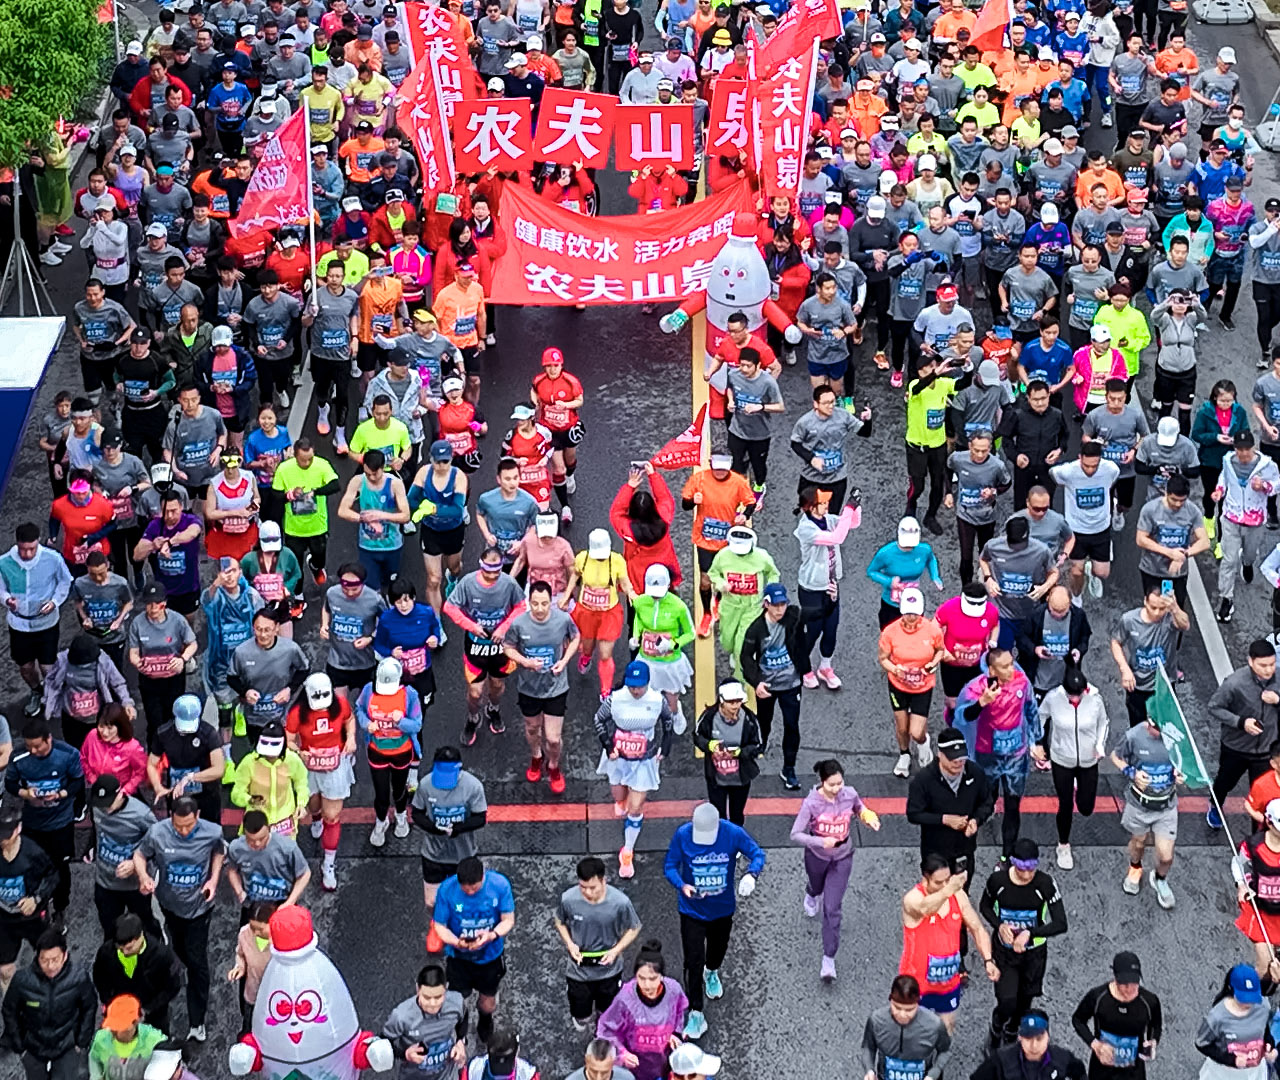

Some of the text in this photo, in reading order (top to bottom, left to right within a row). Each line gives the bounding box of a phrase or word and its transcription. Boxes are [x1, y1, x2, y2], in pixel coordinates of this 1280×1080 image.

[514, 210, 735, 264] 健康饮水 活力奔跑
